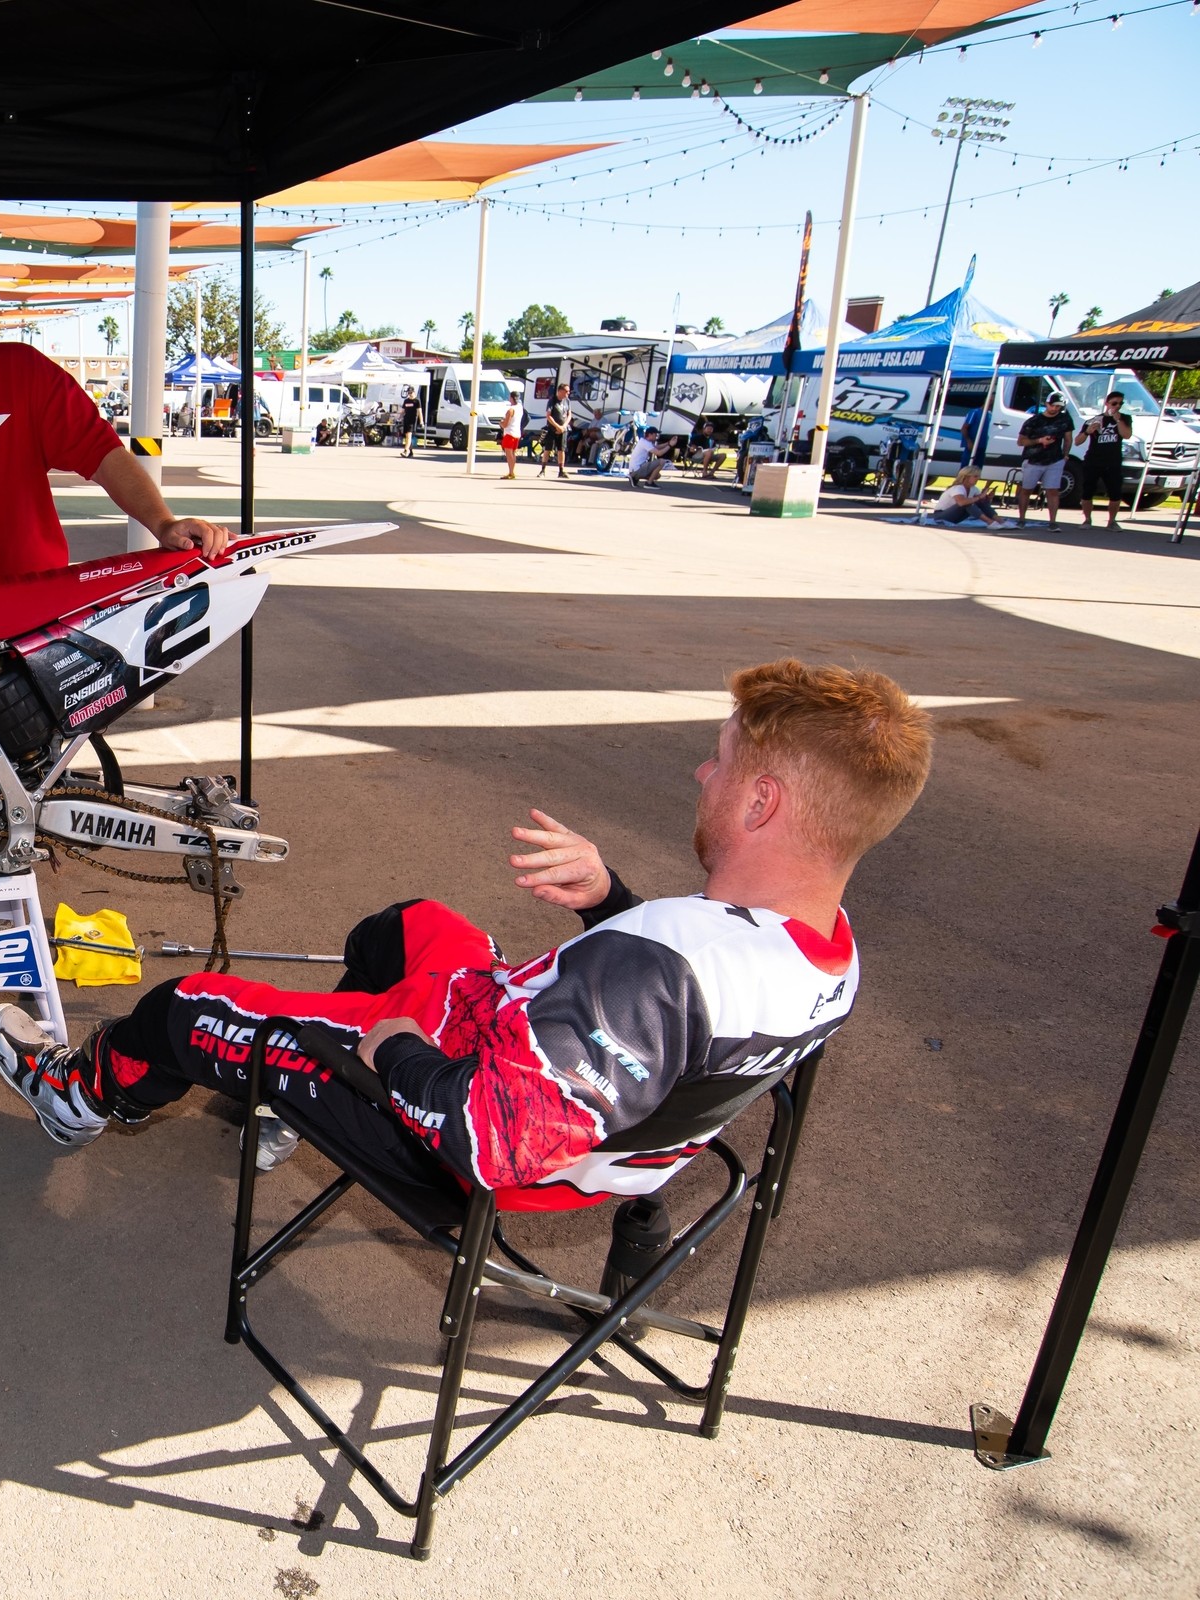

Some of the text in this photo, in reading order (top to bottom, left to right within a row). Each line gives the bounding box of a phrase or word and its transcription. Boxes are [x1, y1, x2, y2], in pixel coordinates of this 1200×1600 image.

[685, 354, 772, 370] WWW.TMRACING-USA.COM
[812, 350, 926, 369] WTMRACING-USA.COM
[1044, 345, 1169, 362] maxxis.com
[236, 533, 317, 562] DUNLOP
[141, 581, 211, 685] 2
[52, 650, 83, 672] YAMALUBE
[69, 809, 157, 847] YAMAHA
[171, 833, 246, 851] TAG
